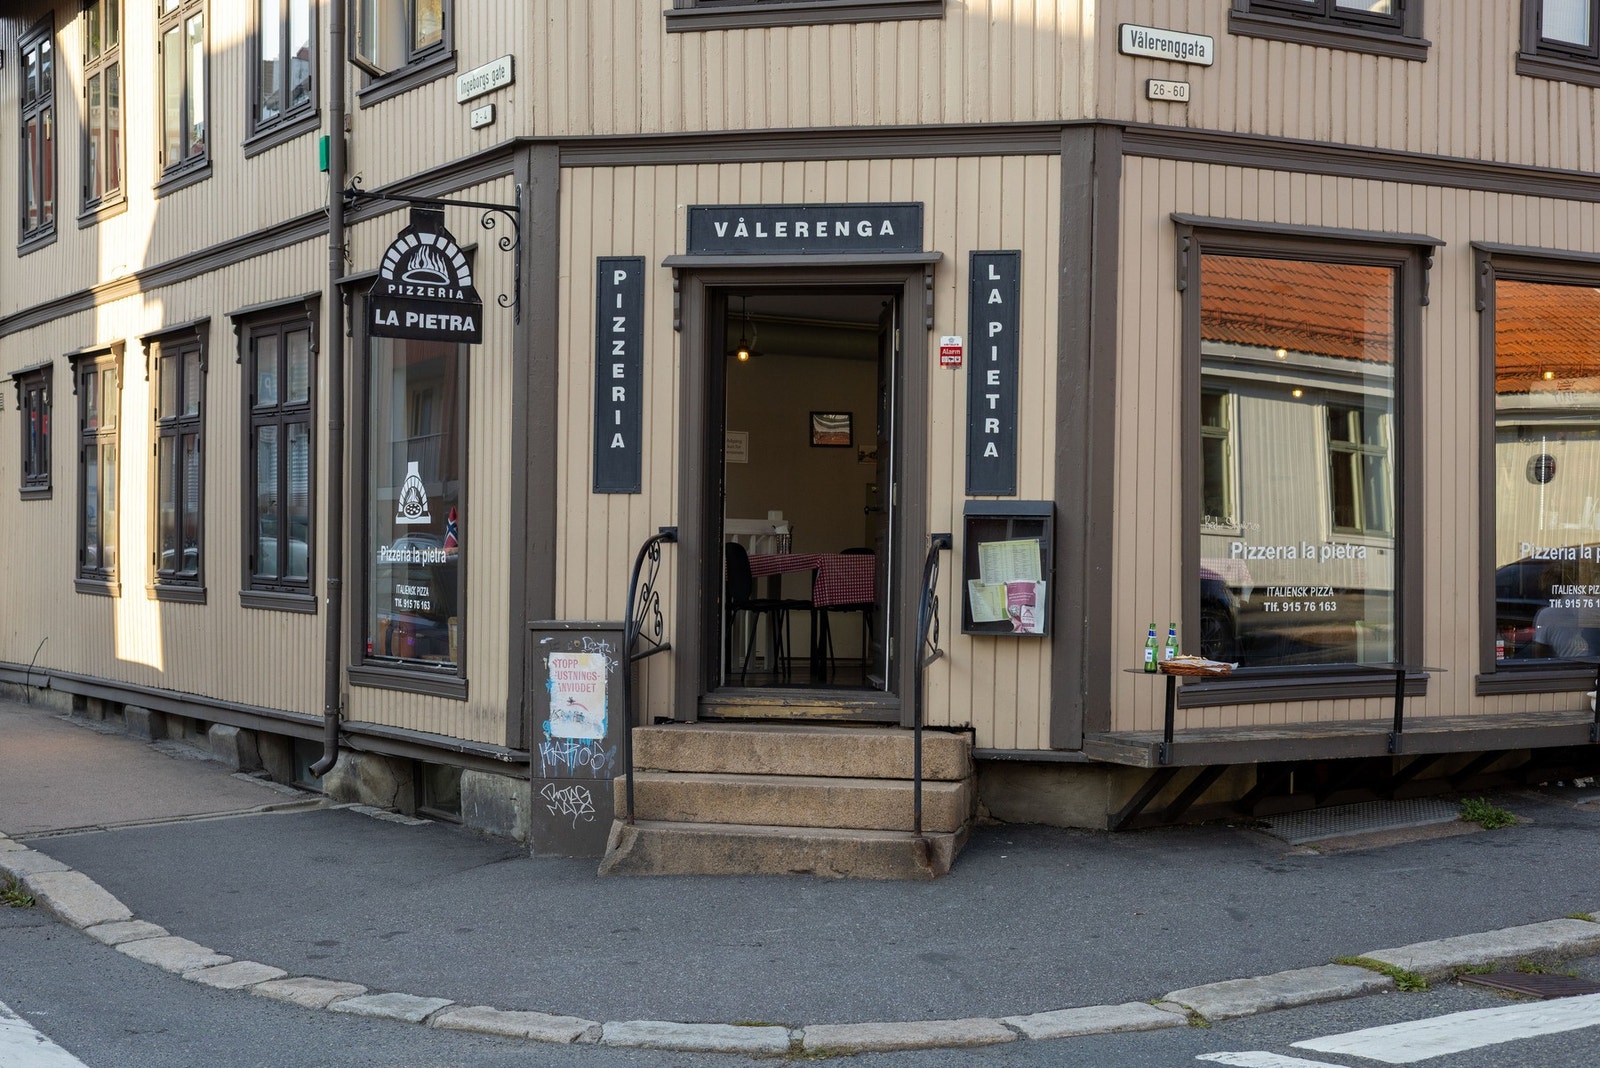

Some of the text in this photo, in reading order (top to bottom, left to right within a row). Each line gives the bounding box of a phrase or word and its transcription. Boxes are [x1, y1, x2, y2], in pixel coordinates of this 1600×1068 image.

[1130, 29, 1205, 59] Vålerenggata
[460, 65, 505, 96] Ingeborgs gate
[714, 217, 894, 238] VÅLERENGA
[387, 284, 464, 300] PIZZERIA
[375, 308, 475, 332] LA PIETRA
[610, 270, 627, 448] PIZZERIA
[983, 264, 1003, 458] LA PIETRA
[380, 545, 447, 567] Pizzeria la pietra
[1231, 541, 1367, 564] Pizzeria la pietra
[1521, 542, 1576, 560] Pizzeria
[1580, 542, 1592, 559] la
[395, 584, 430, 597] ITALIENSK PIZZA
[1266, 586, 1334, 597] ITALIENSK PIZZA
[1551, 584, 1587, 595] ITALIENSK
[403, 599, 413, 609] 915
[413, 600, 421, 610] 76
[421, 600, 431, 611] 163
[1263, 601, 1337, 612] Tlf. 915 76 163
[1549, 599, 1563, 609] Tlf.
[1565, 599, 1581, 609] 915
[1583, 599, 1594, 609] 76
